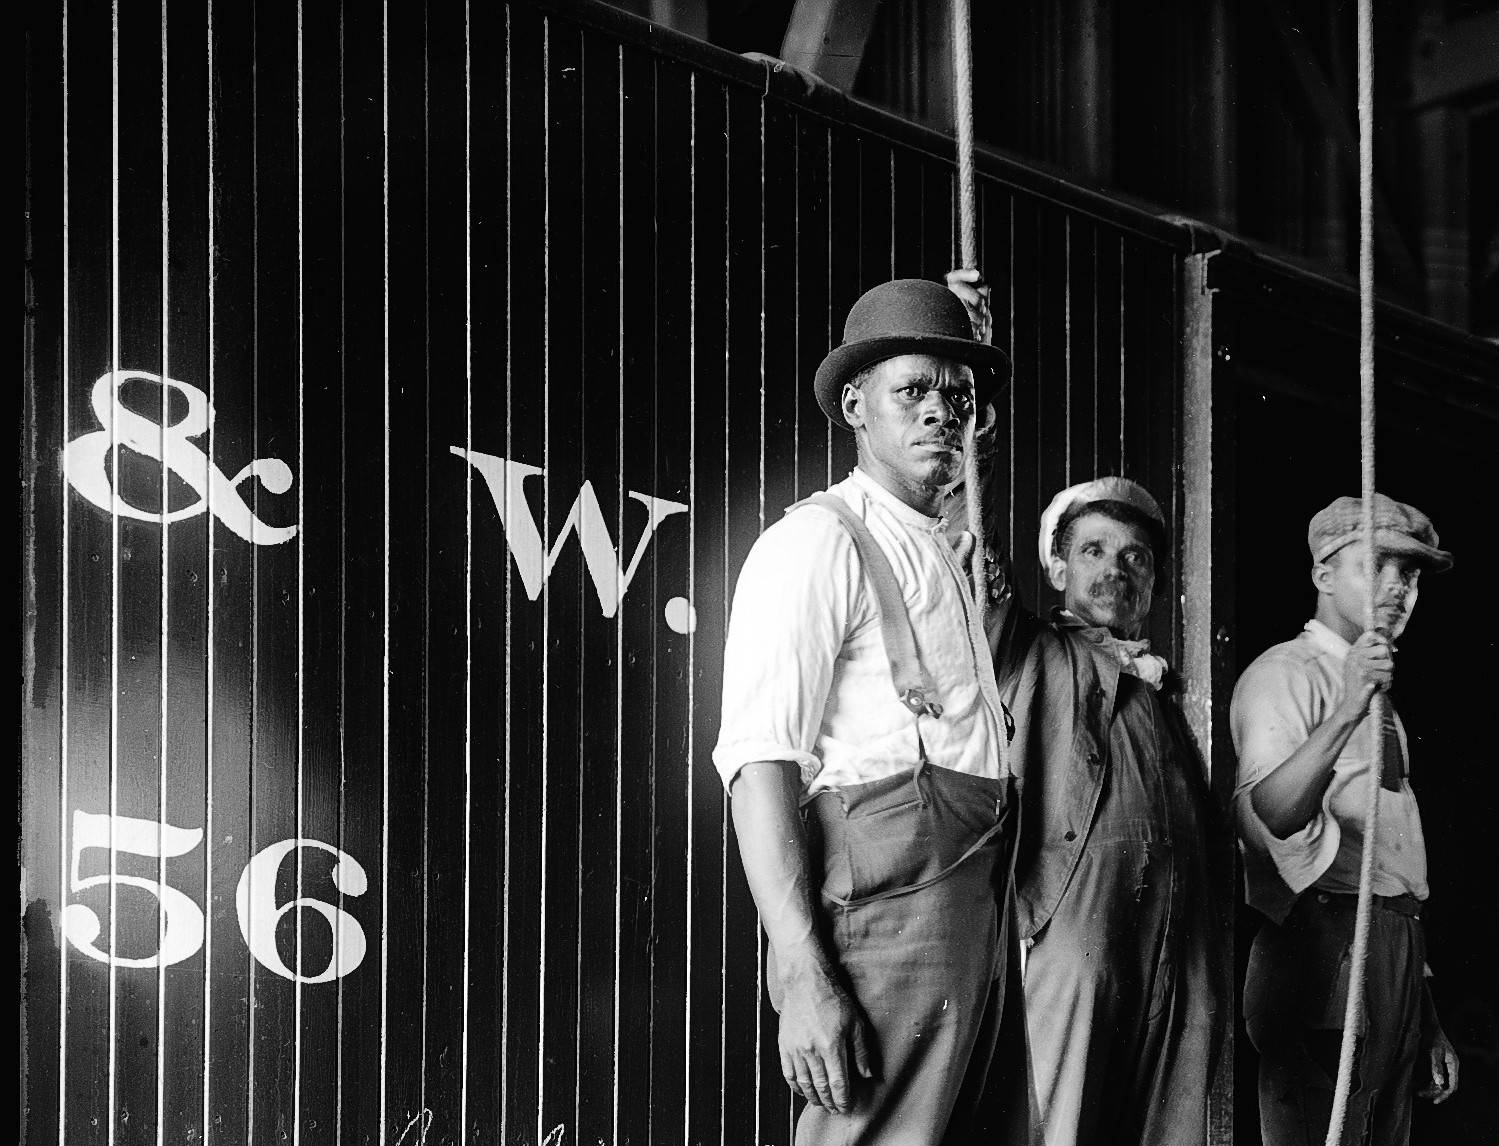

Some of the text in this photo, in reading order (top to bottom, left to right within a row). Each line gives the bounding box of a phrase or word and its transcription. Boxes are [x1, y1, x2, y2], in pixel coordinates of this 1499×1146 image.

[63, 369, 697, 635] & W.
[62, 809, 368, 984] 56
